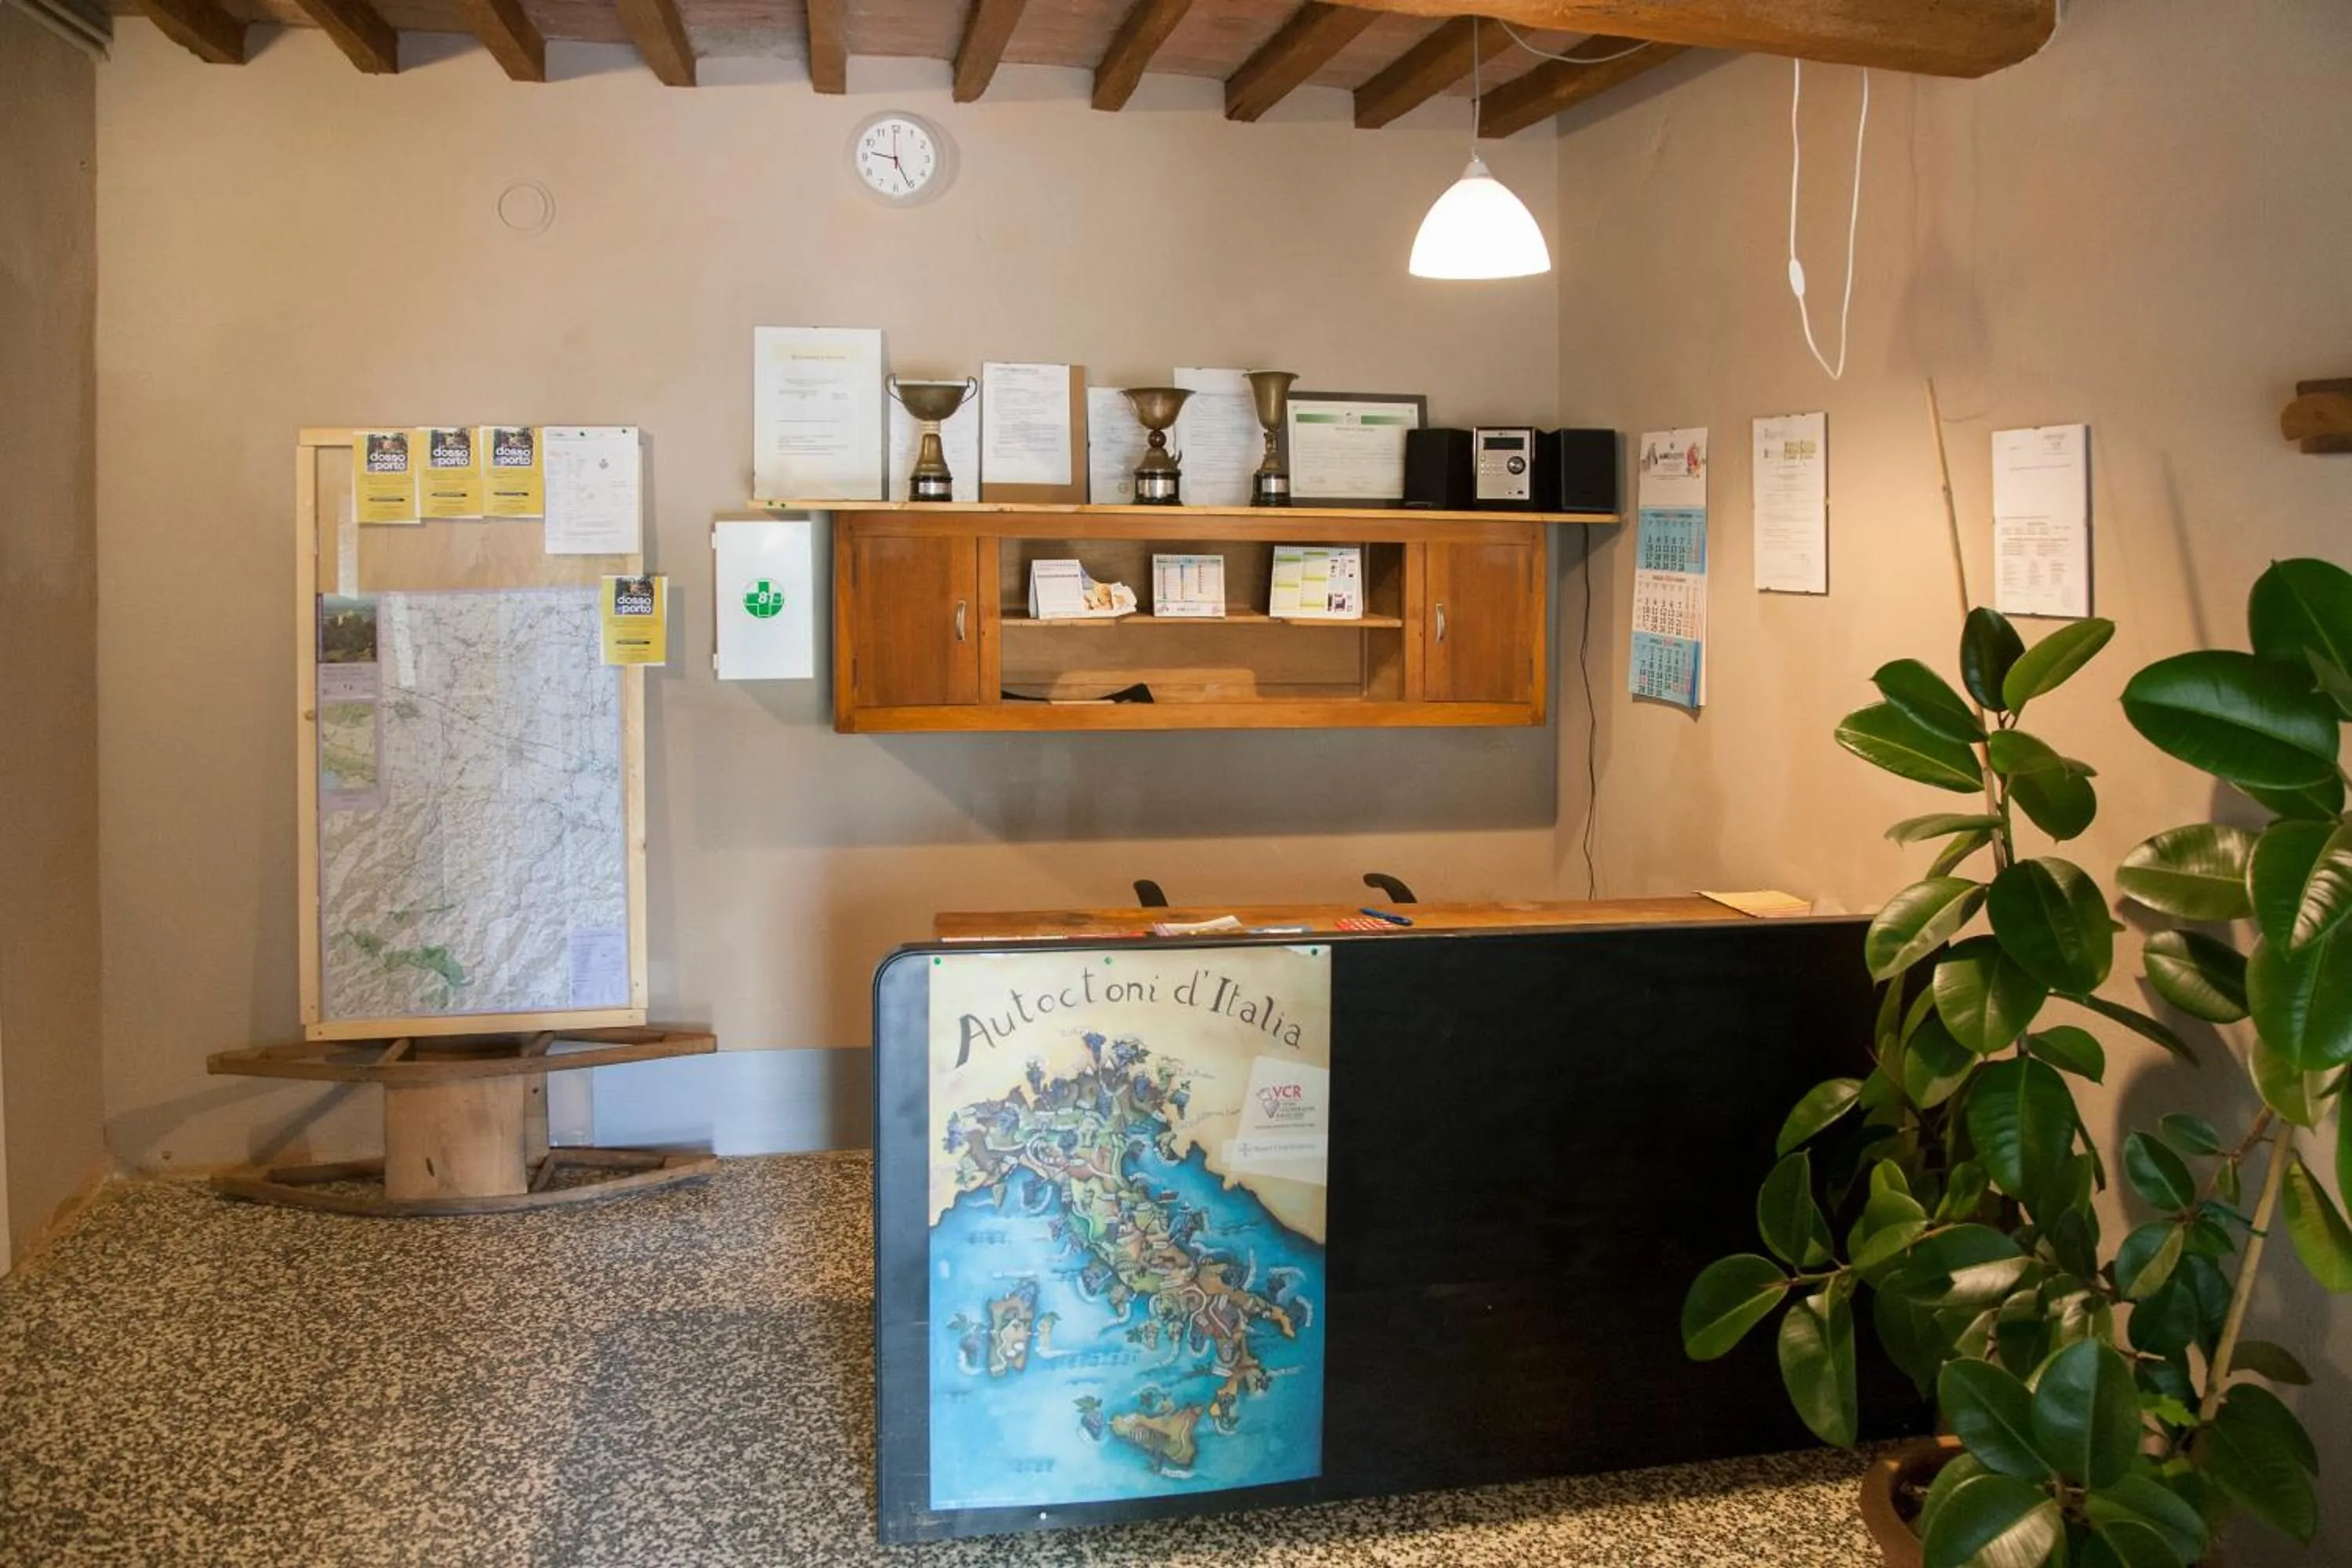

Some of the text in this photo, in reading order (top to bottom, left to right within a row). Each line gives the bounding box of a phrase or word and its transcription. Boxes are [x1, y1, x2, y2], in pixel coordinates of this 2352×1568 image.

[955, 967, 1301, 1068] Autoctoni d'Italia
[1272, 1085, 1302, 1098] VCR
